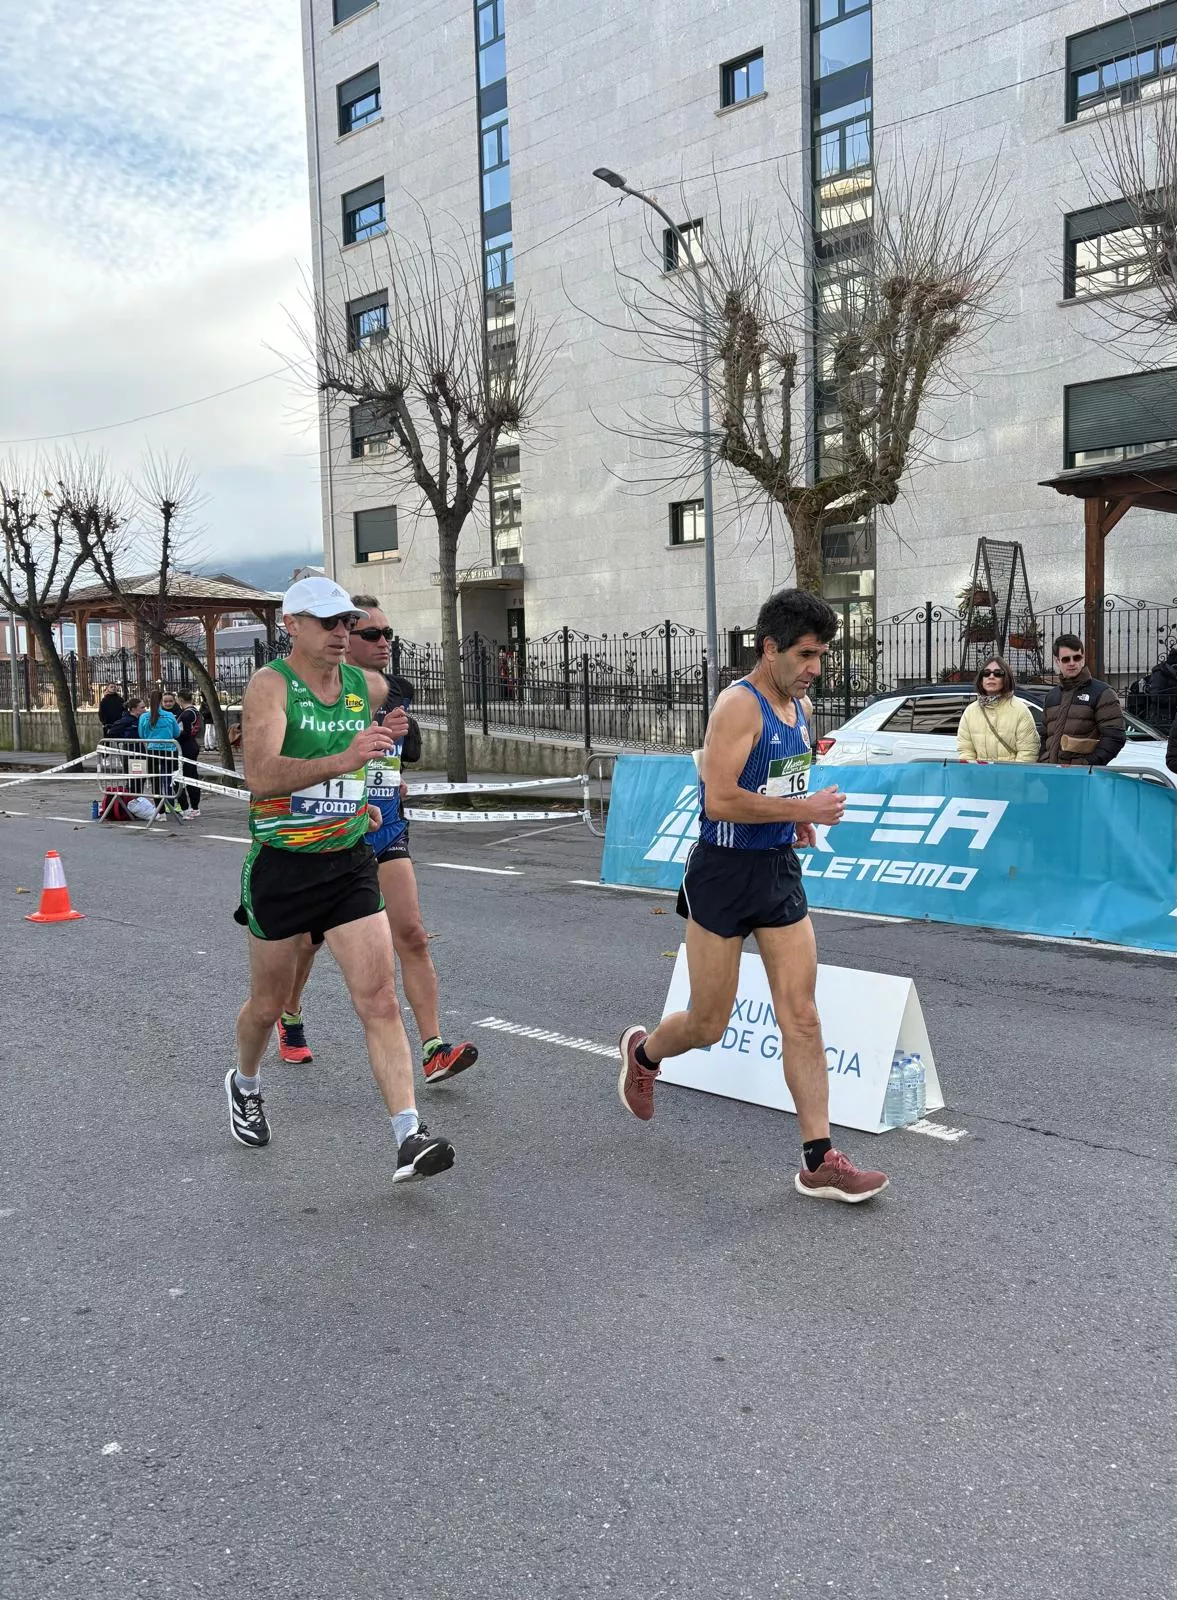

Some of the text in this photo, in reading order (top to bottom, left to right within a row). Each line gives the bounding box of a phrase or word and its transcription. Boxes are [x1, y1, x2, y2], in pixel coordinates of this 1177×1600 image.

[301, 715, 365, 732] Huesca
[374, 771, 383, 785] 8
[789, 773, 805, 793] 16
[322, 780, 344, 798] 11
[730, 998, 777, 1028] XUN
[721, 1026, 861, 1078] DE GCIA
